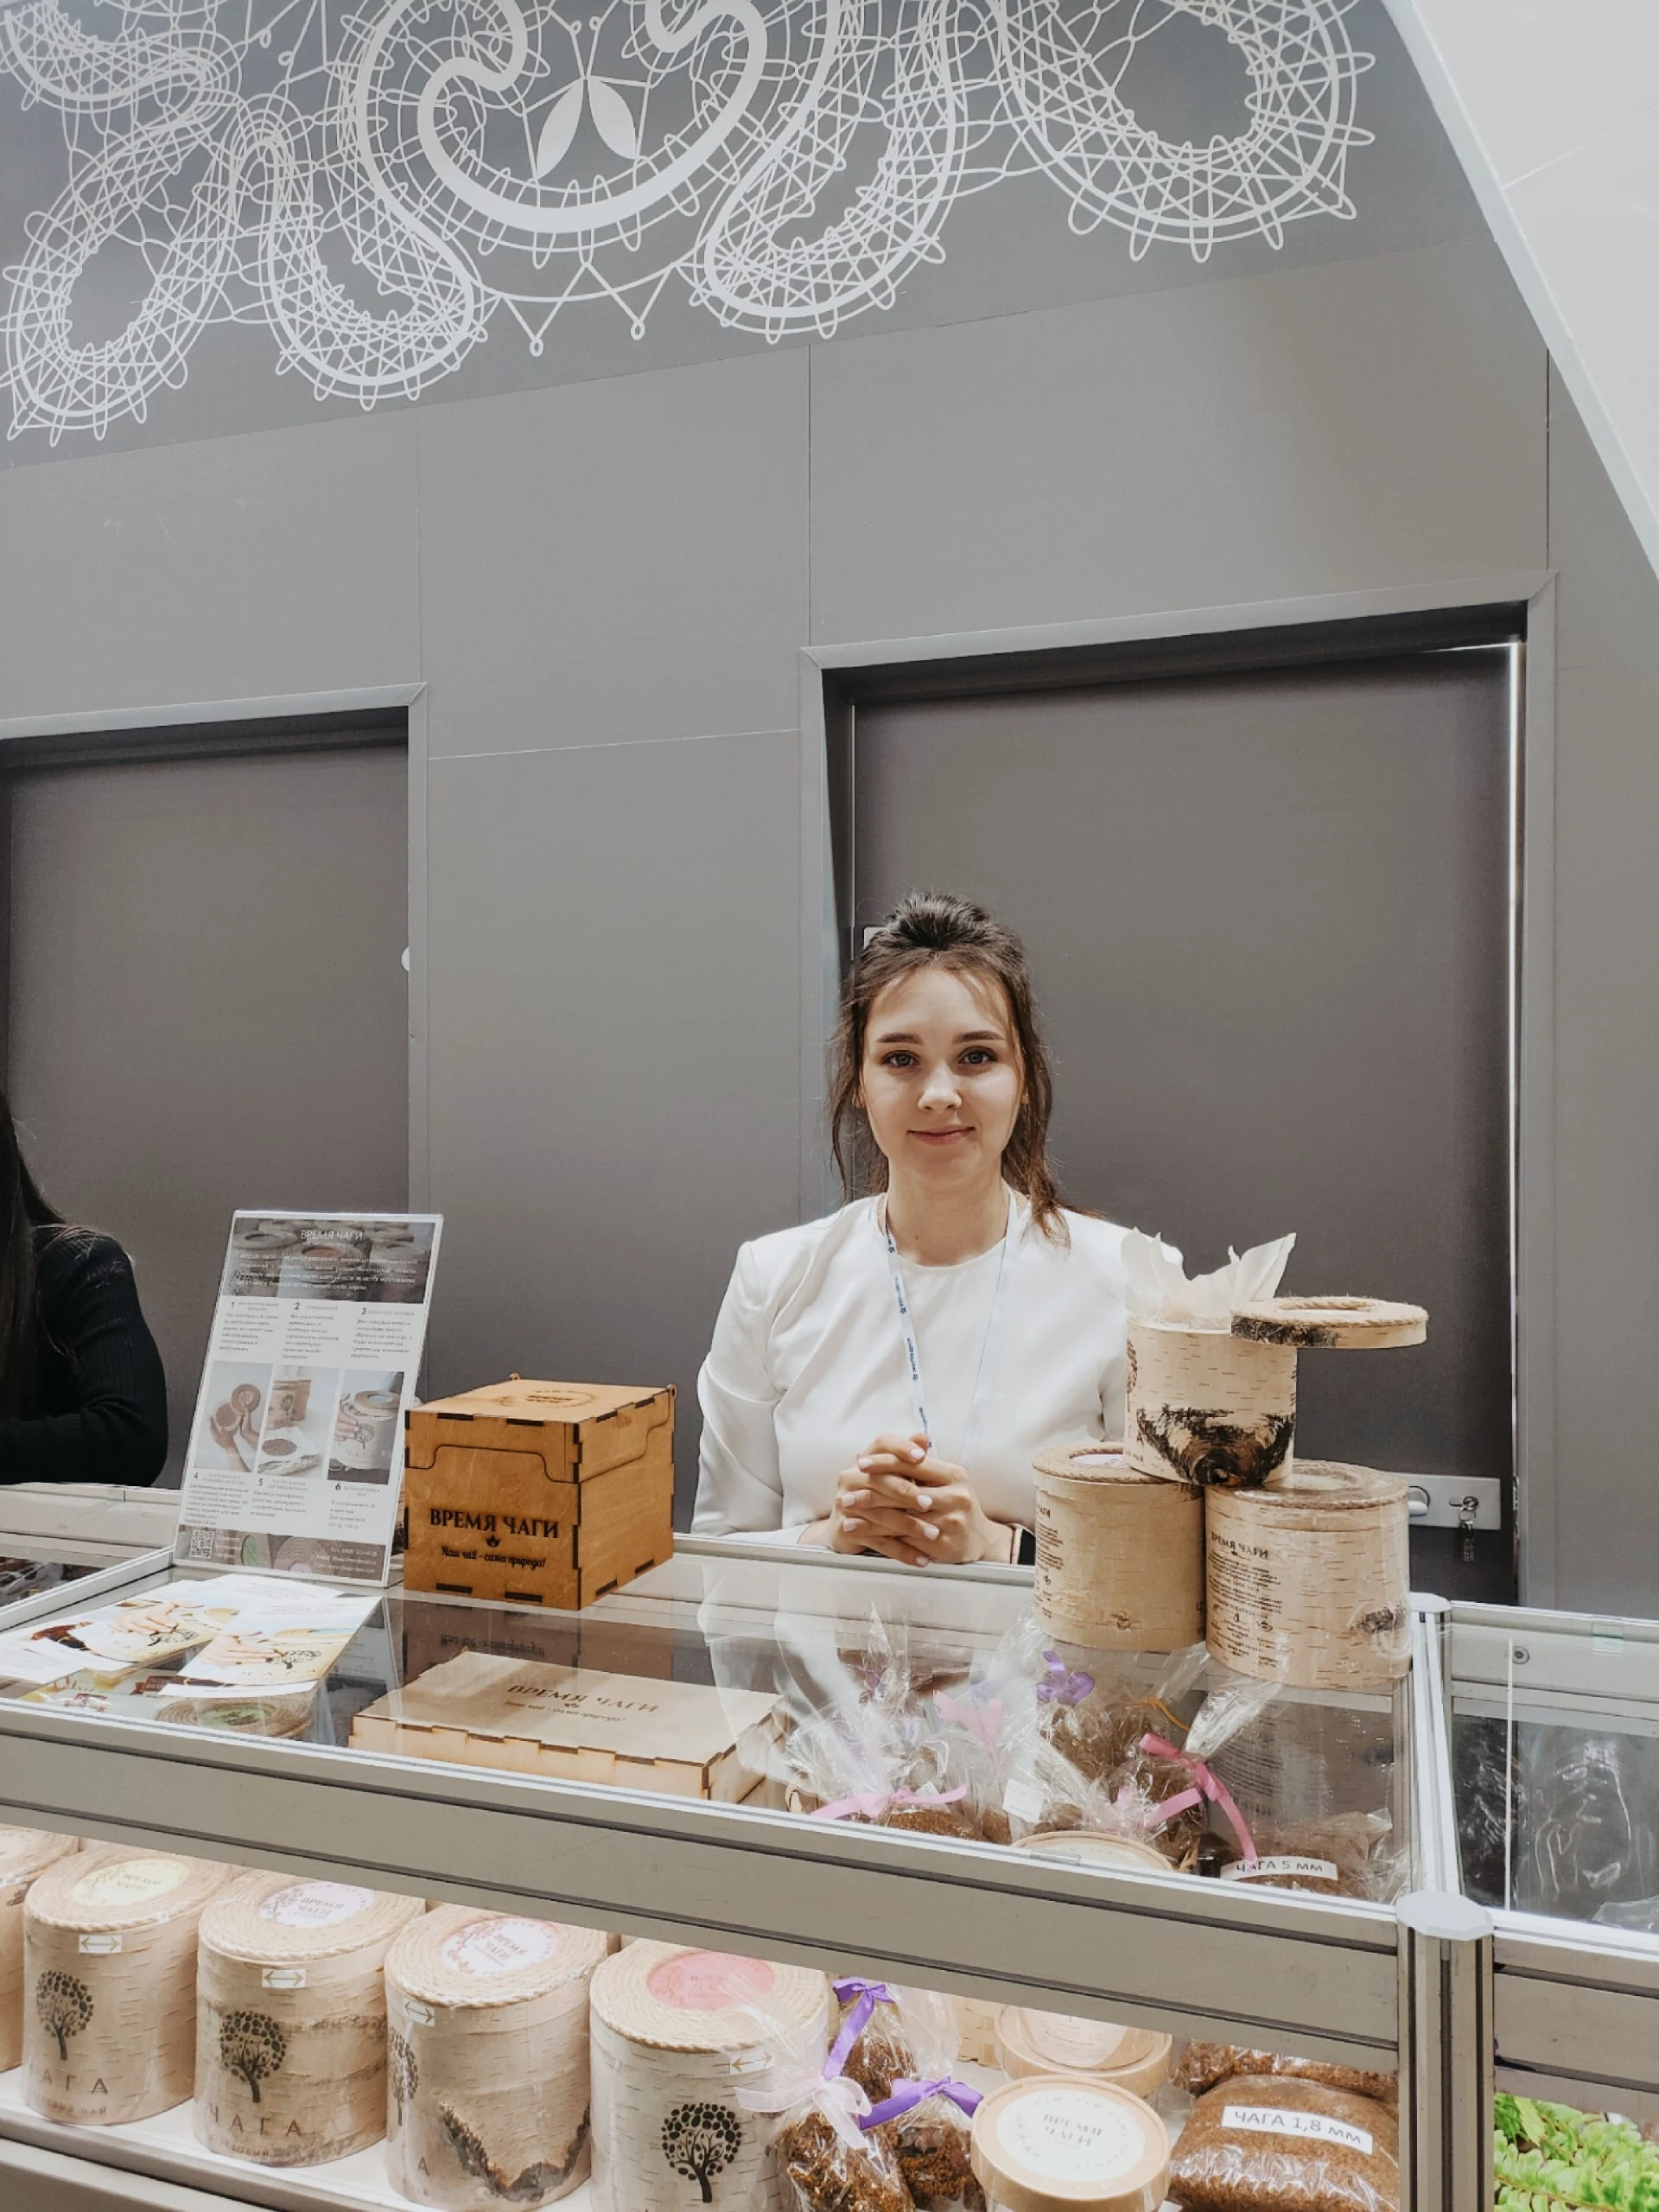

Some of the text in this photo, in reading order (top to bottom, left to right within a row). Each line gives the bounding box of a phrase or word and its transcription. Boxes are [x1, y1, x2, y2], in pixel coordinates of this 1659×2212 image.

[301, 1230, 363, 1242] ВРЕМЯ ЧАГИ
[258, 1478, 264, 1486] 5
[334, 1483, 341, 1491] 6
[429, 1508, 559, 1539] ВРЕМЯ ЧАГИ
[442, 1545, 461, 1558] Наш
[462, 1549, 478, 1560] чай
[484, 1554, 507, 1564] сама
[506, 1684, 659, 1713] ВРЕМЯ ЧАГИ
[1281, 1860, 1290, 1870] 5
[40, 2067, 109, 2095] АГА
[208, 2102, 302, 2138] ЧАГА
[1235, 2111, 1285, 2126] ЧАГА
[1292, 2118, 1322, 2133] 1,8
